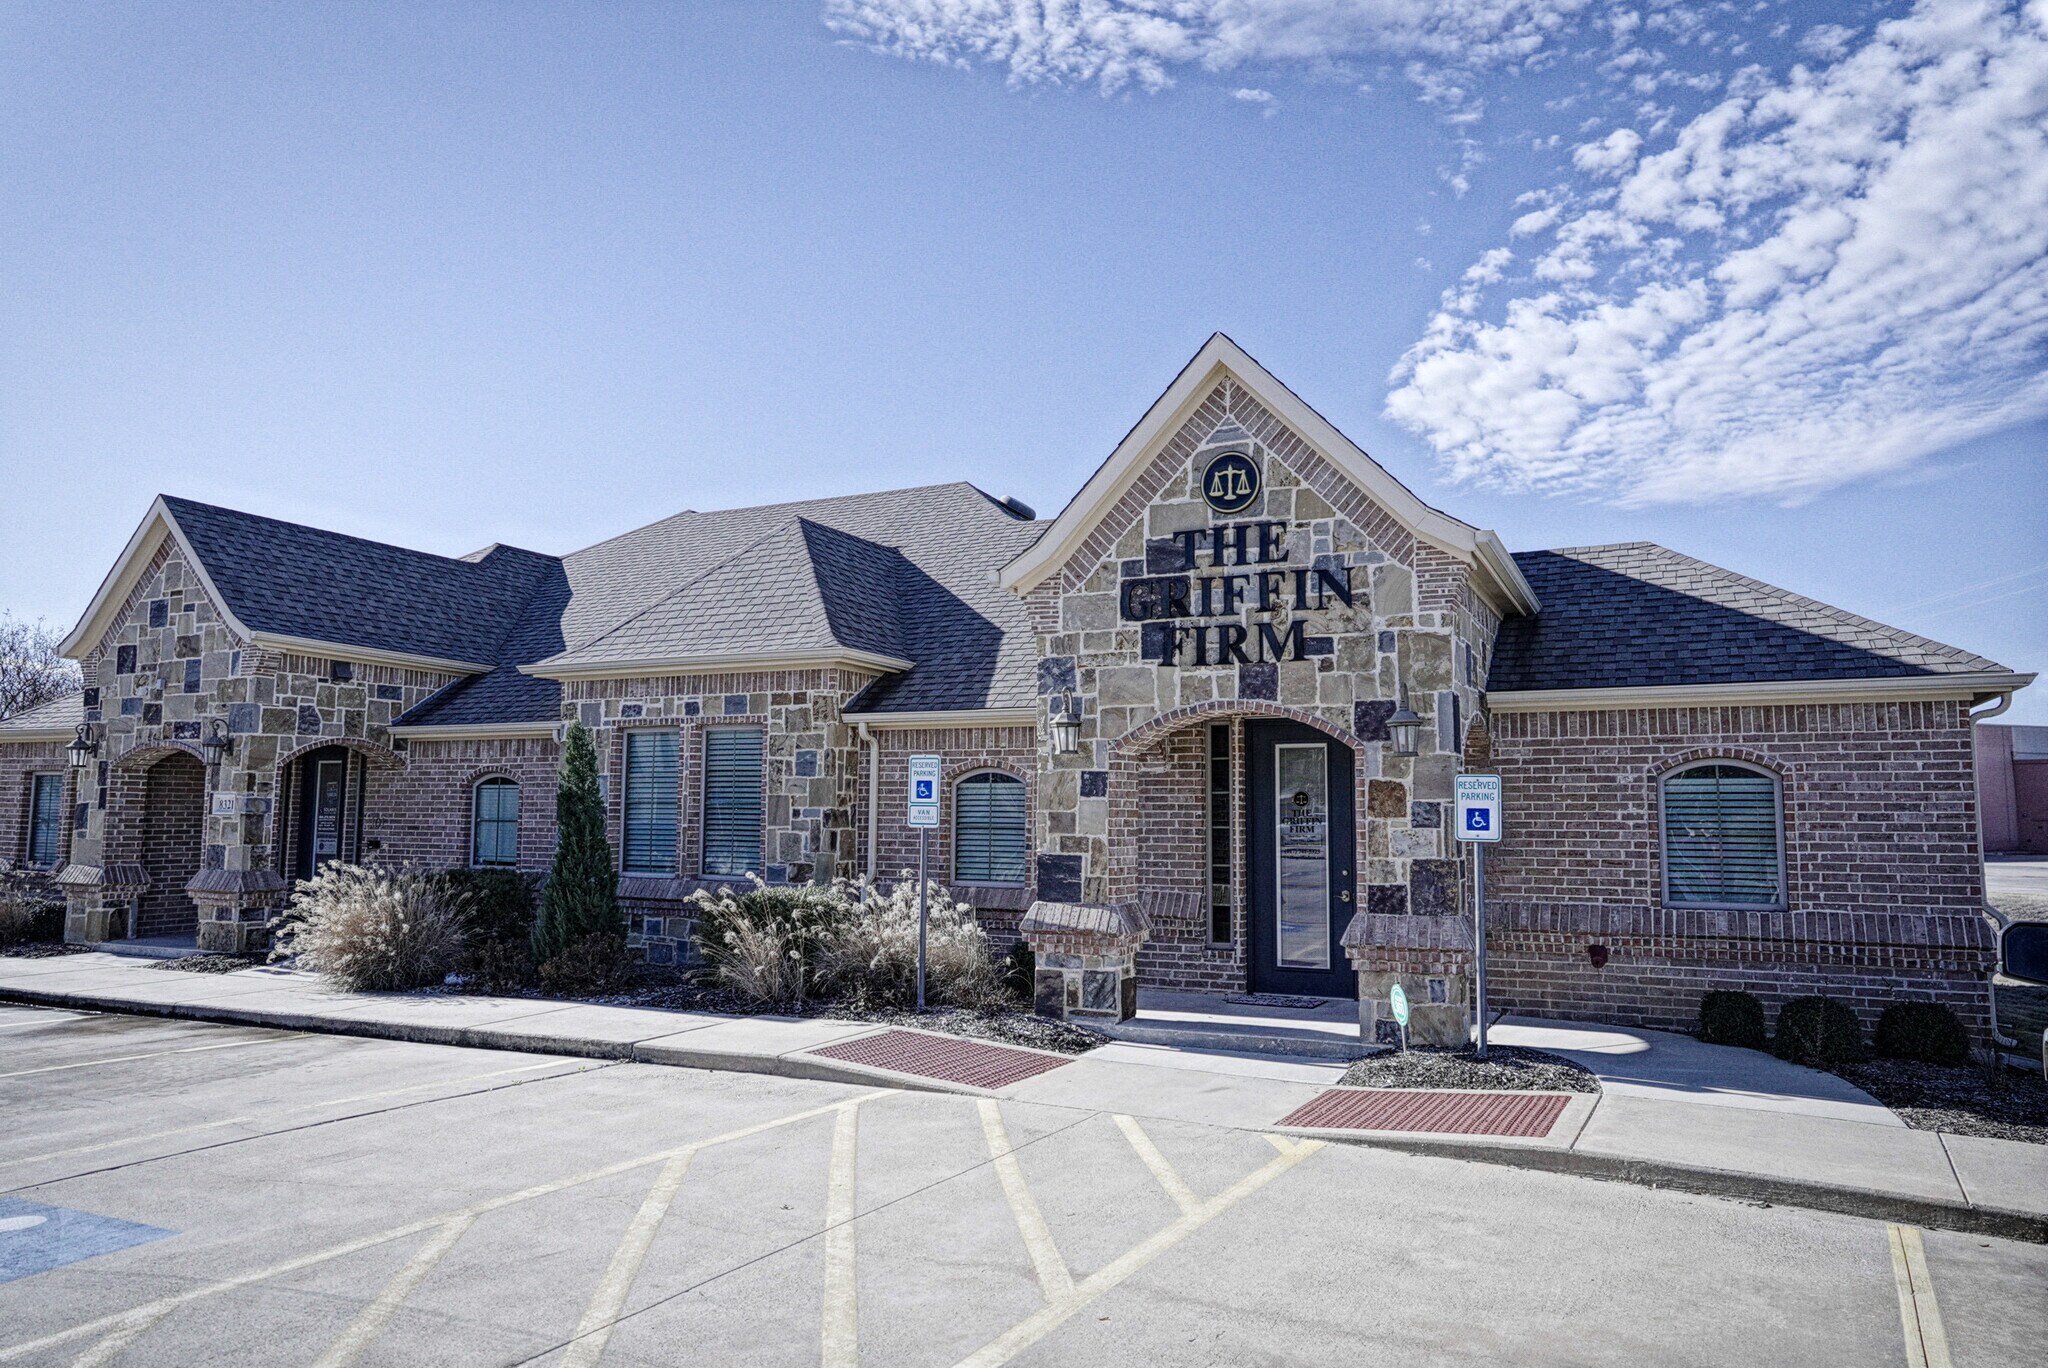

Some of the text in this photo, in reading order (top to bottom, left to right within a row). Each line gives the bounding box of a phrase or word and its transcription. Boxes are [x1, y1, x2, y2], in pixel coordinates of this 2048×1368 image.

[1173, 521, 1289, 571] THE
[1121, 567, 1355, 621] GRIFFIN
[1157, 619, 1310, 667] FIRM
[1458, 781, 1497, 790] RESERVED
[1461, 792, 1495, 801] PARKING
[219, 799, 234, 810] 8321
[1292, 809, 1312, 817] THE
[1281, 816, 1322, 825] GRIFFIN
[1289, 825, 1315, 833] FIRM
